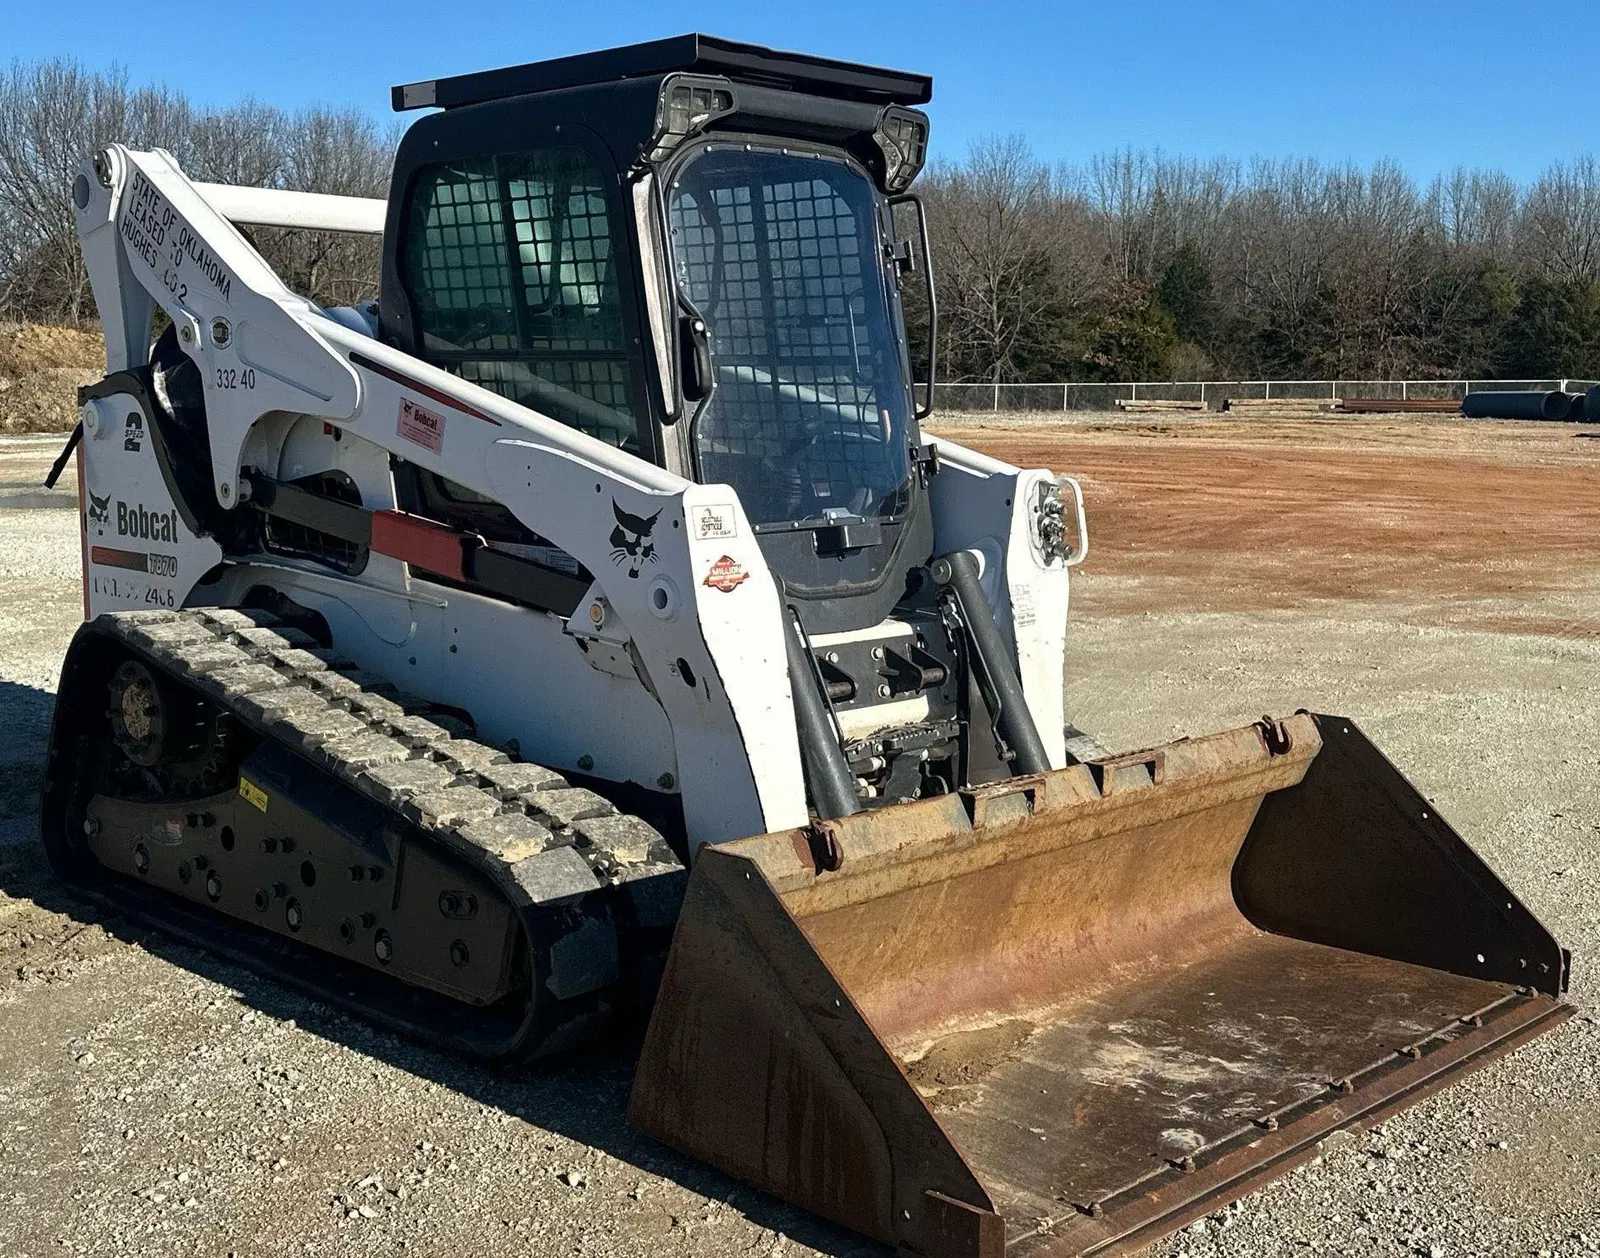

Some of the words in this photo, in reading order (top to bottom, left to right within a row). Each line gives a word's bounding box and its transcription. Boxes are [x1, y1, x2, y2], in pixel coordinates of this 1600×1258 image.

[121, 215, 158, 268] HUGHES
[129, 194, 165, 246] LEASED
[133, 172, 161, 216] STATE
[162, 207, 177, 231] OF
[179, 227, 231, 301] OKLAHOMA
[124, 428, 145, 439] SPEED
[413, 408, 438, 431] Bobcat
[116, 501, 178, 544] Bobcat
[149, 553, 178, 578] T870
